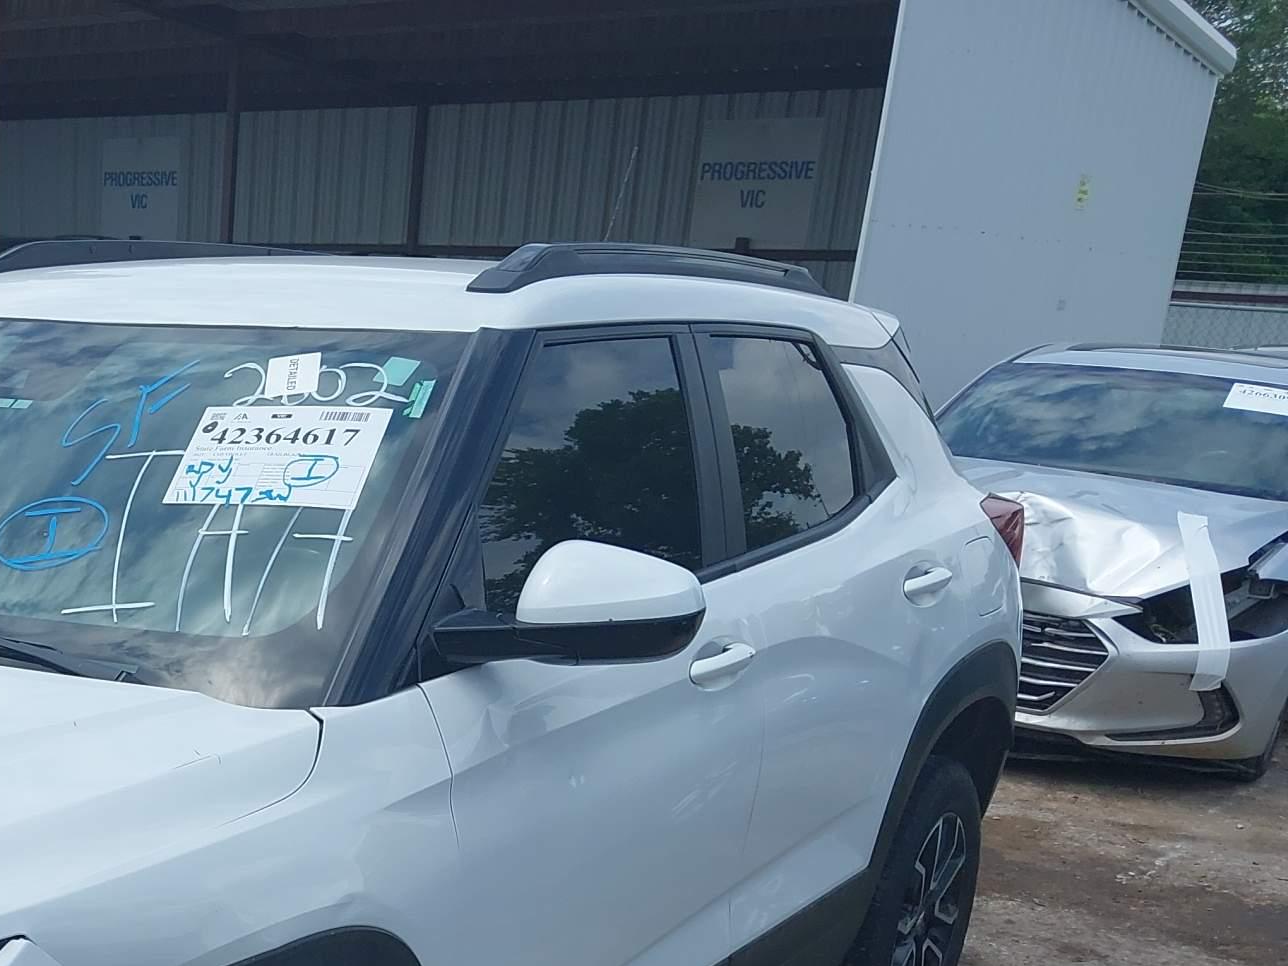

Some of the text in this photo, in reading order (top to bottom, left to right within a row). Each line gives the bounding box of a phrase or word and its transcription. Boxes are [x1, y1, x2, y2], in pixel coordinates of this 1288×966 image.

[103, 170, 177, 187] PROGRESSIVE
[701, 160, 816, 181] PROGRESSIVE
[130, 193, 149, 209] VIC
[740, 189, 766, 208] VIC
[286, 357, 300, 391] DETAILED
[210, 426, 361, 447] 42364617
